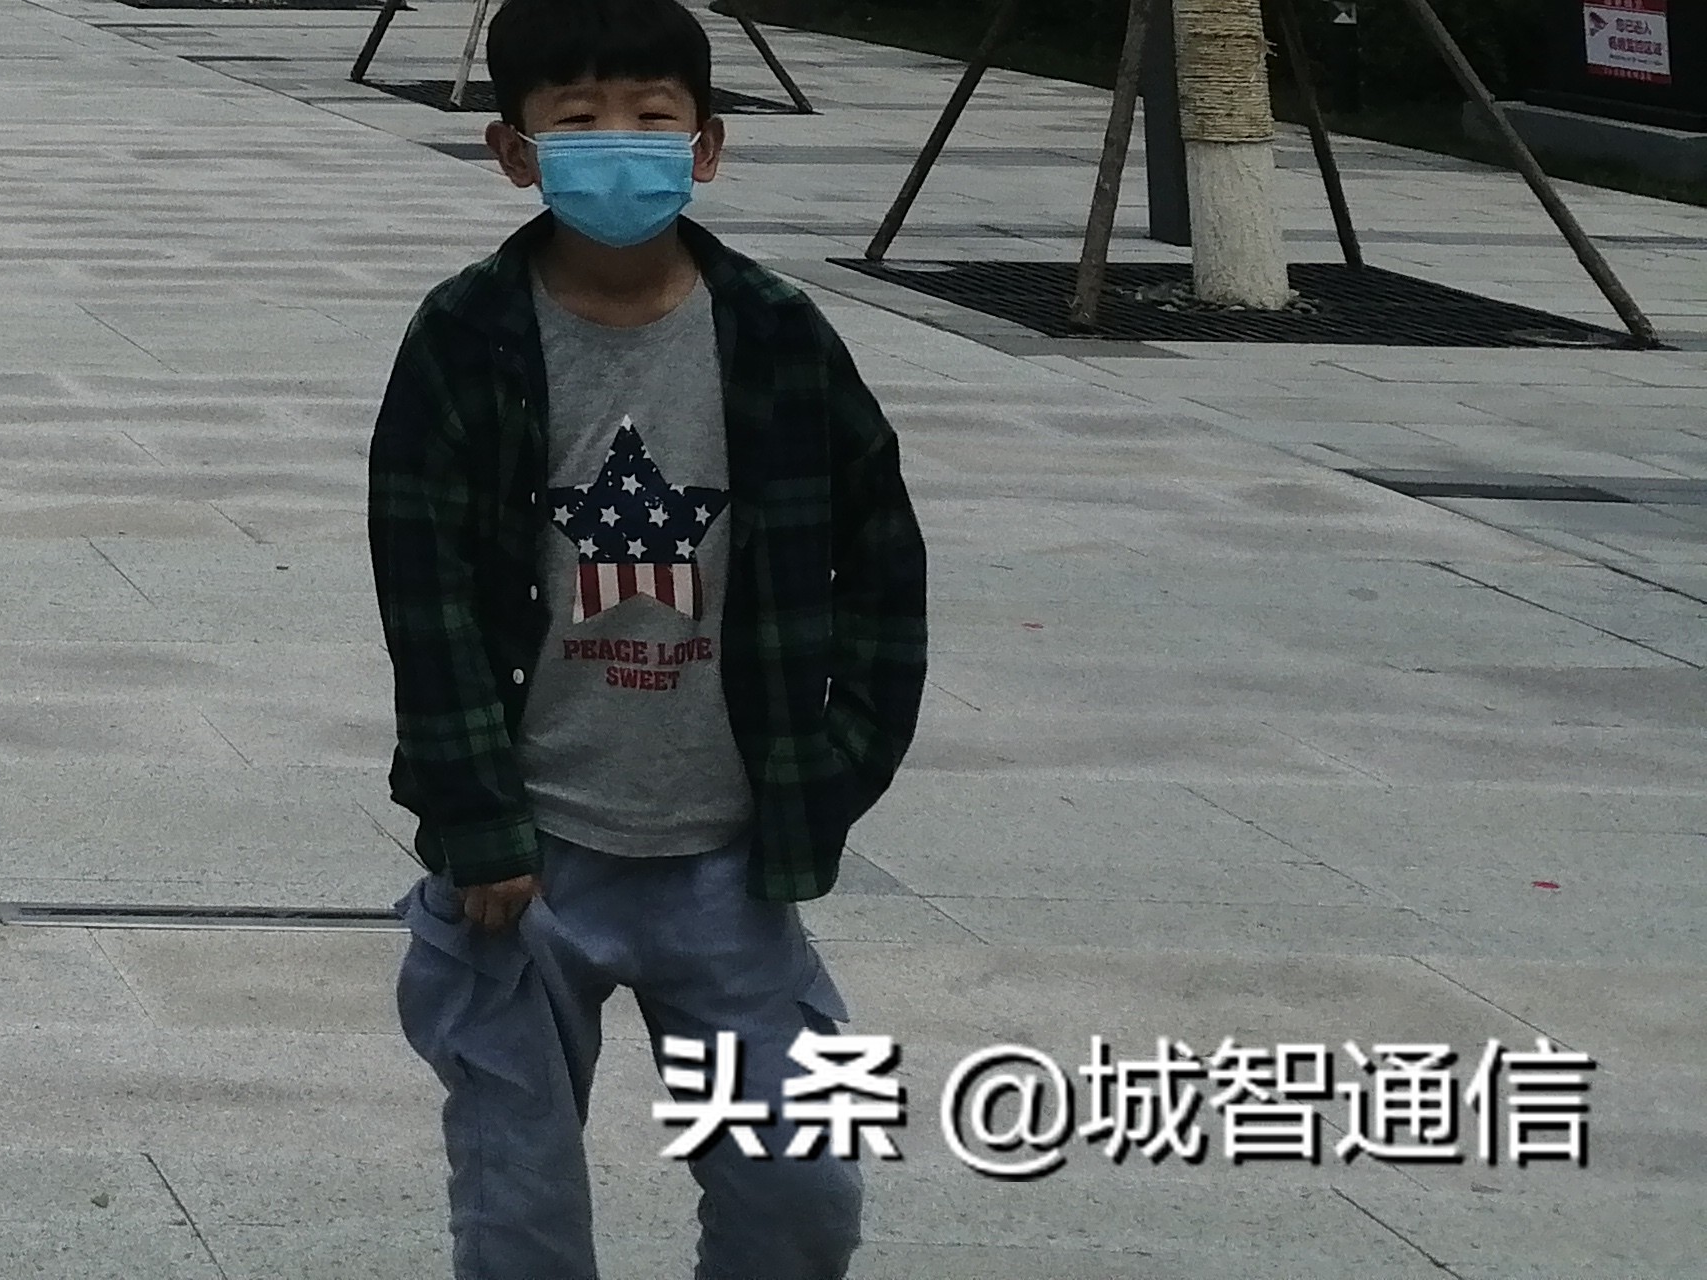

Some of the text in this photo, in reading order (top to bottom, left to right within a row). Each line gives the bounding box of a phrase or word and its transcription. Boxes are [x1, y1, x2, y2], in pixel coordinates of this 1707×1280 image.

[563, 637, 712, 665] PEACE LOVE
[605, 666, 680, 691] SWEET
